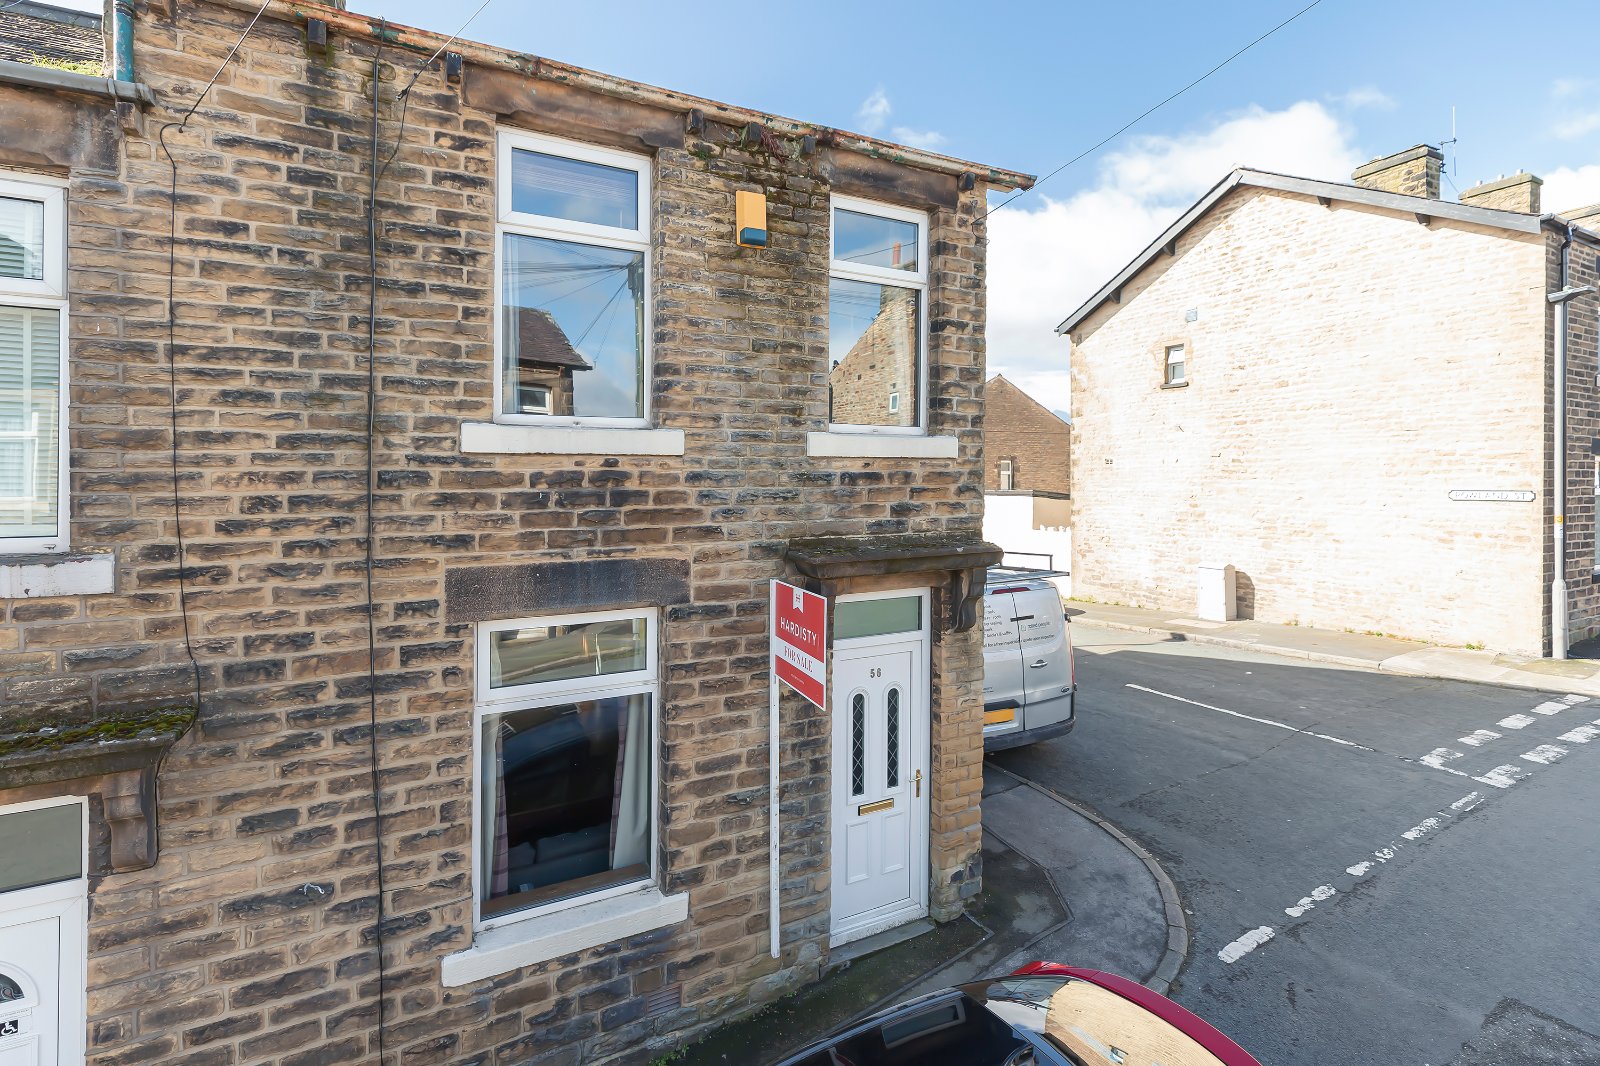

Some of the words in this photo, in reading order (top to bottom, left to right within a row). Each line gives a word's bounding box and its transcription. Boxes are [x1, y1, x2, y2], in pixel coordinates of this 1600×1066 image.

[1515, 492, 1527, 500] ST
[780, 616, 817, 646] HARDISTY
[784, 645, 796, 663] FOR
[795, 652, 813, 673] SALE
[869, 667, 882, 679] 56
